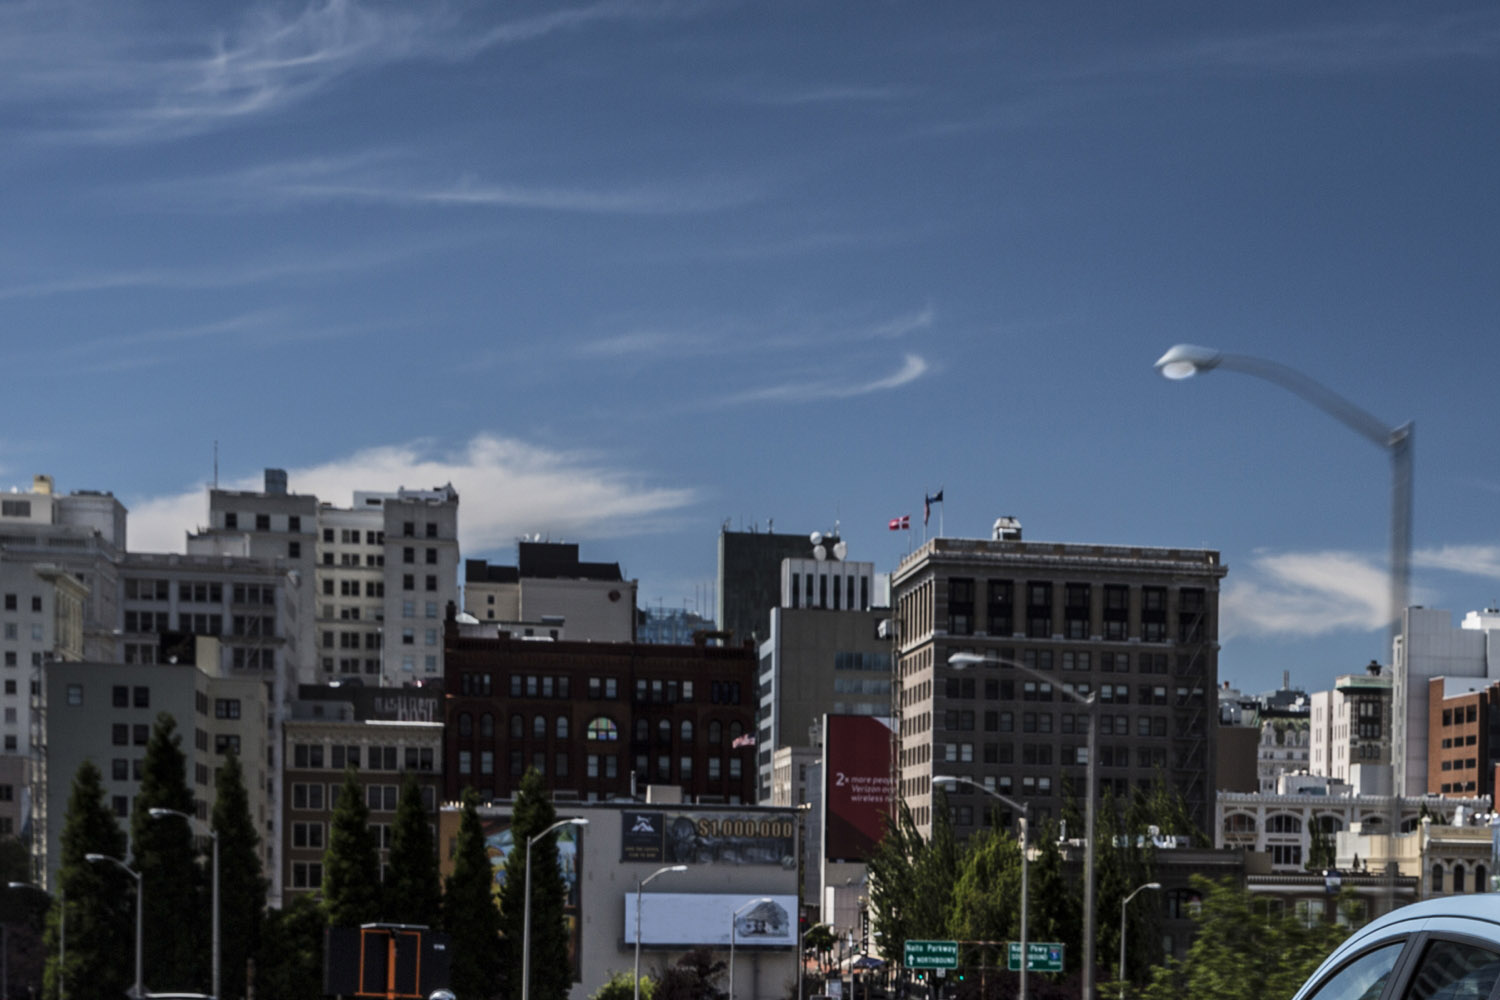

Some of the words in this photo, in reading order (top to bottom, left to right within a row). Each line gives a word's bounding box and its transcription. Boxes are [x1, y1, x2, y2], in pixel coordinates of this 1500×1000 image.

[852, 785, 881, 793] Verizon
[851, 794, 883, 802] wireless
[927, 944, 956, 954] Parkway
